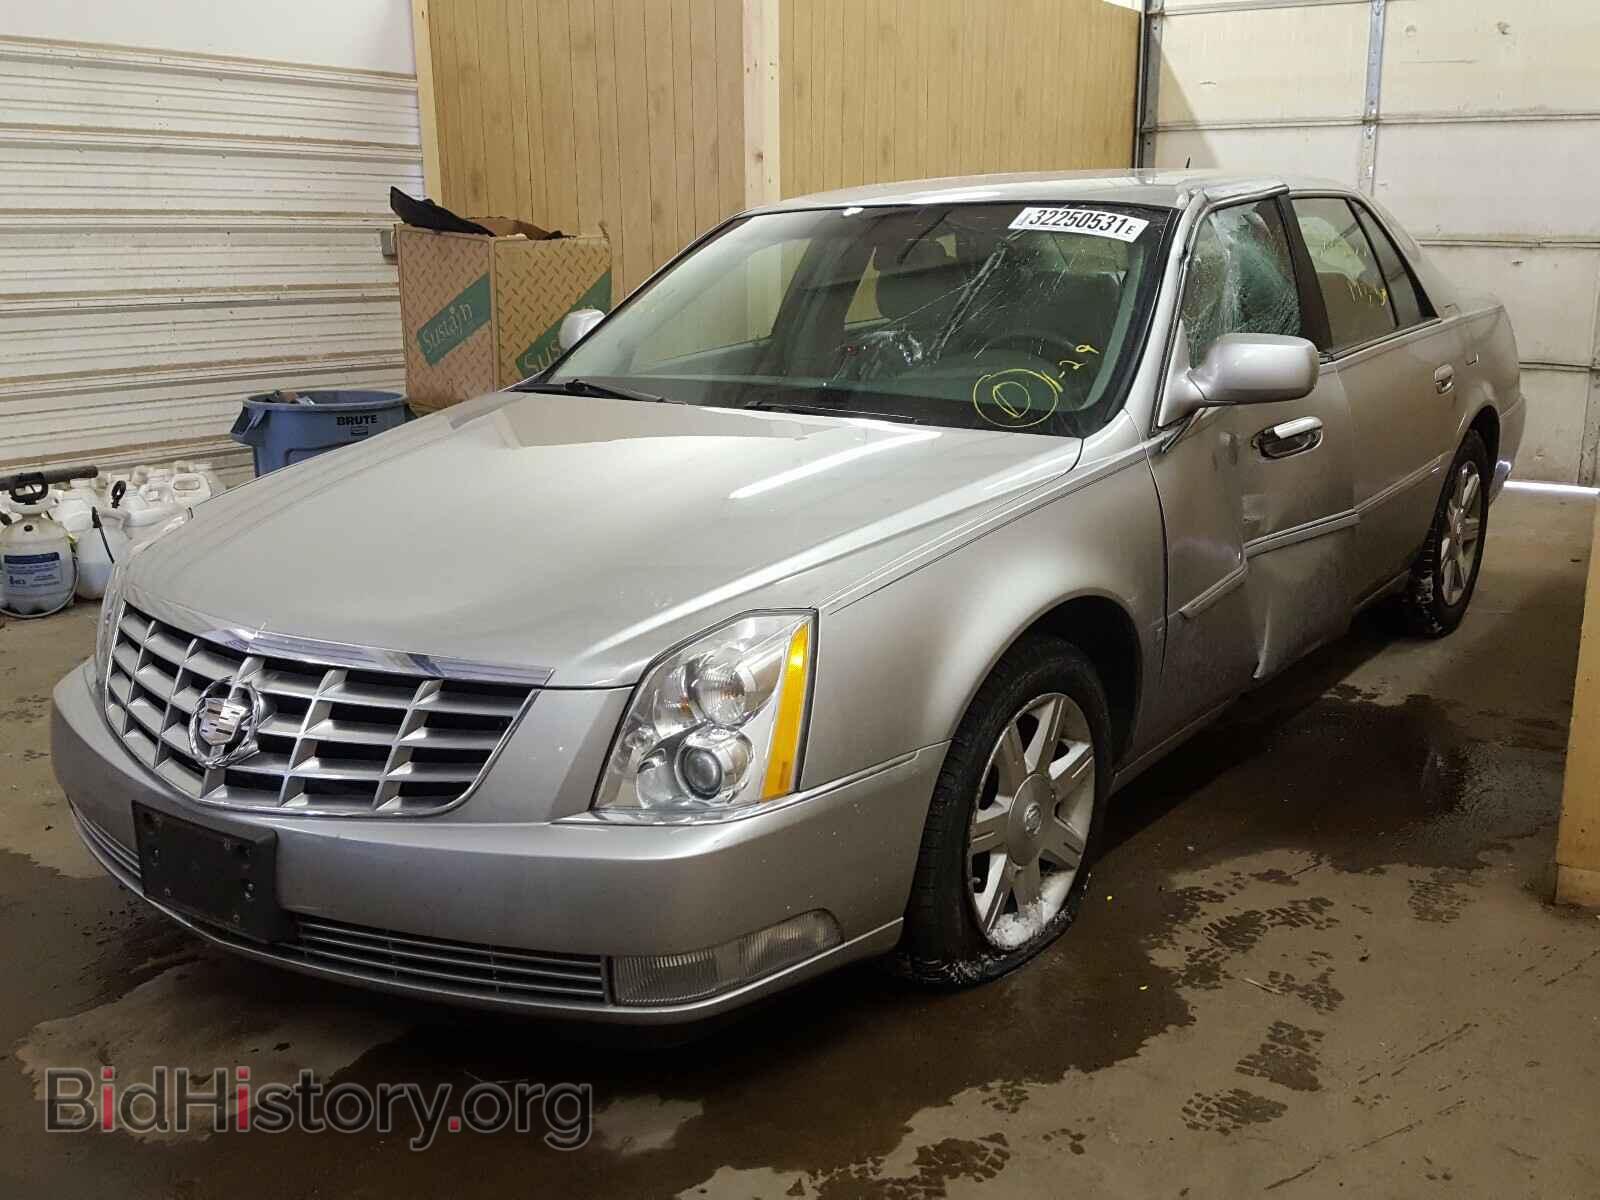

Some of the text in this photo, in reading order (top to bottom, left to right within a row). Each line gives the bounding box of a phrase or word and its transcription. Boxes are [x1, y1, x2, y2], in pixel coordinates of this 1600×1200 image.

[1029, 209, 1129, 234] 32250531
[422, 303, 473, 354] Sustain
[336, 414, 377, 426] BRUTE
